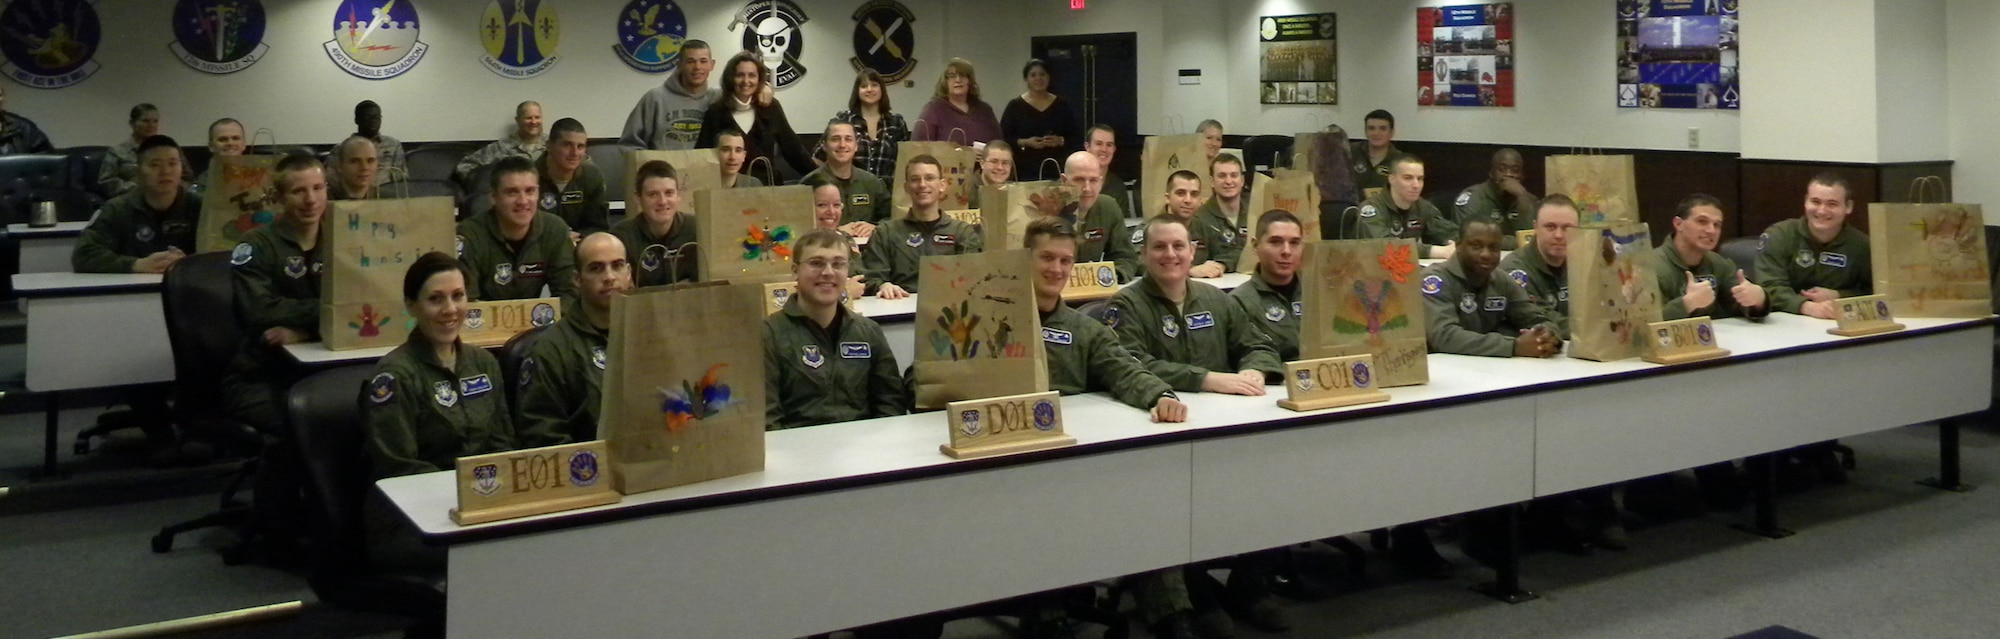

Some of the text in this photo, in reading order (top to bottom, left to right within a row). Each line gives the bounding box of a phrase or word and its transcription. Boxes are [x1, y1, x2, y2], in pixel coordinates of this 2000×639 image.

[332, 46, 423, 77] 490TH MISSILE SQUADRON
[502, 67, 524, 76] MISSILE
[526, 56, 557, 76] SQUADRON
[1671, 324, 1698, 347] B01
[1317, 361, 1352, 390] C01
[984, 400, 1032, 434] D01
[508, 452, 565, 494] E01
